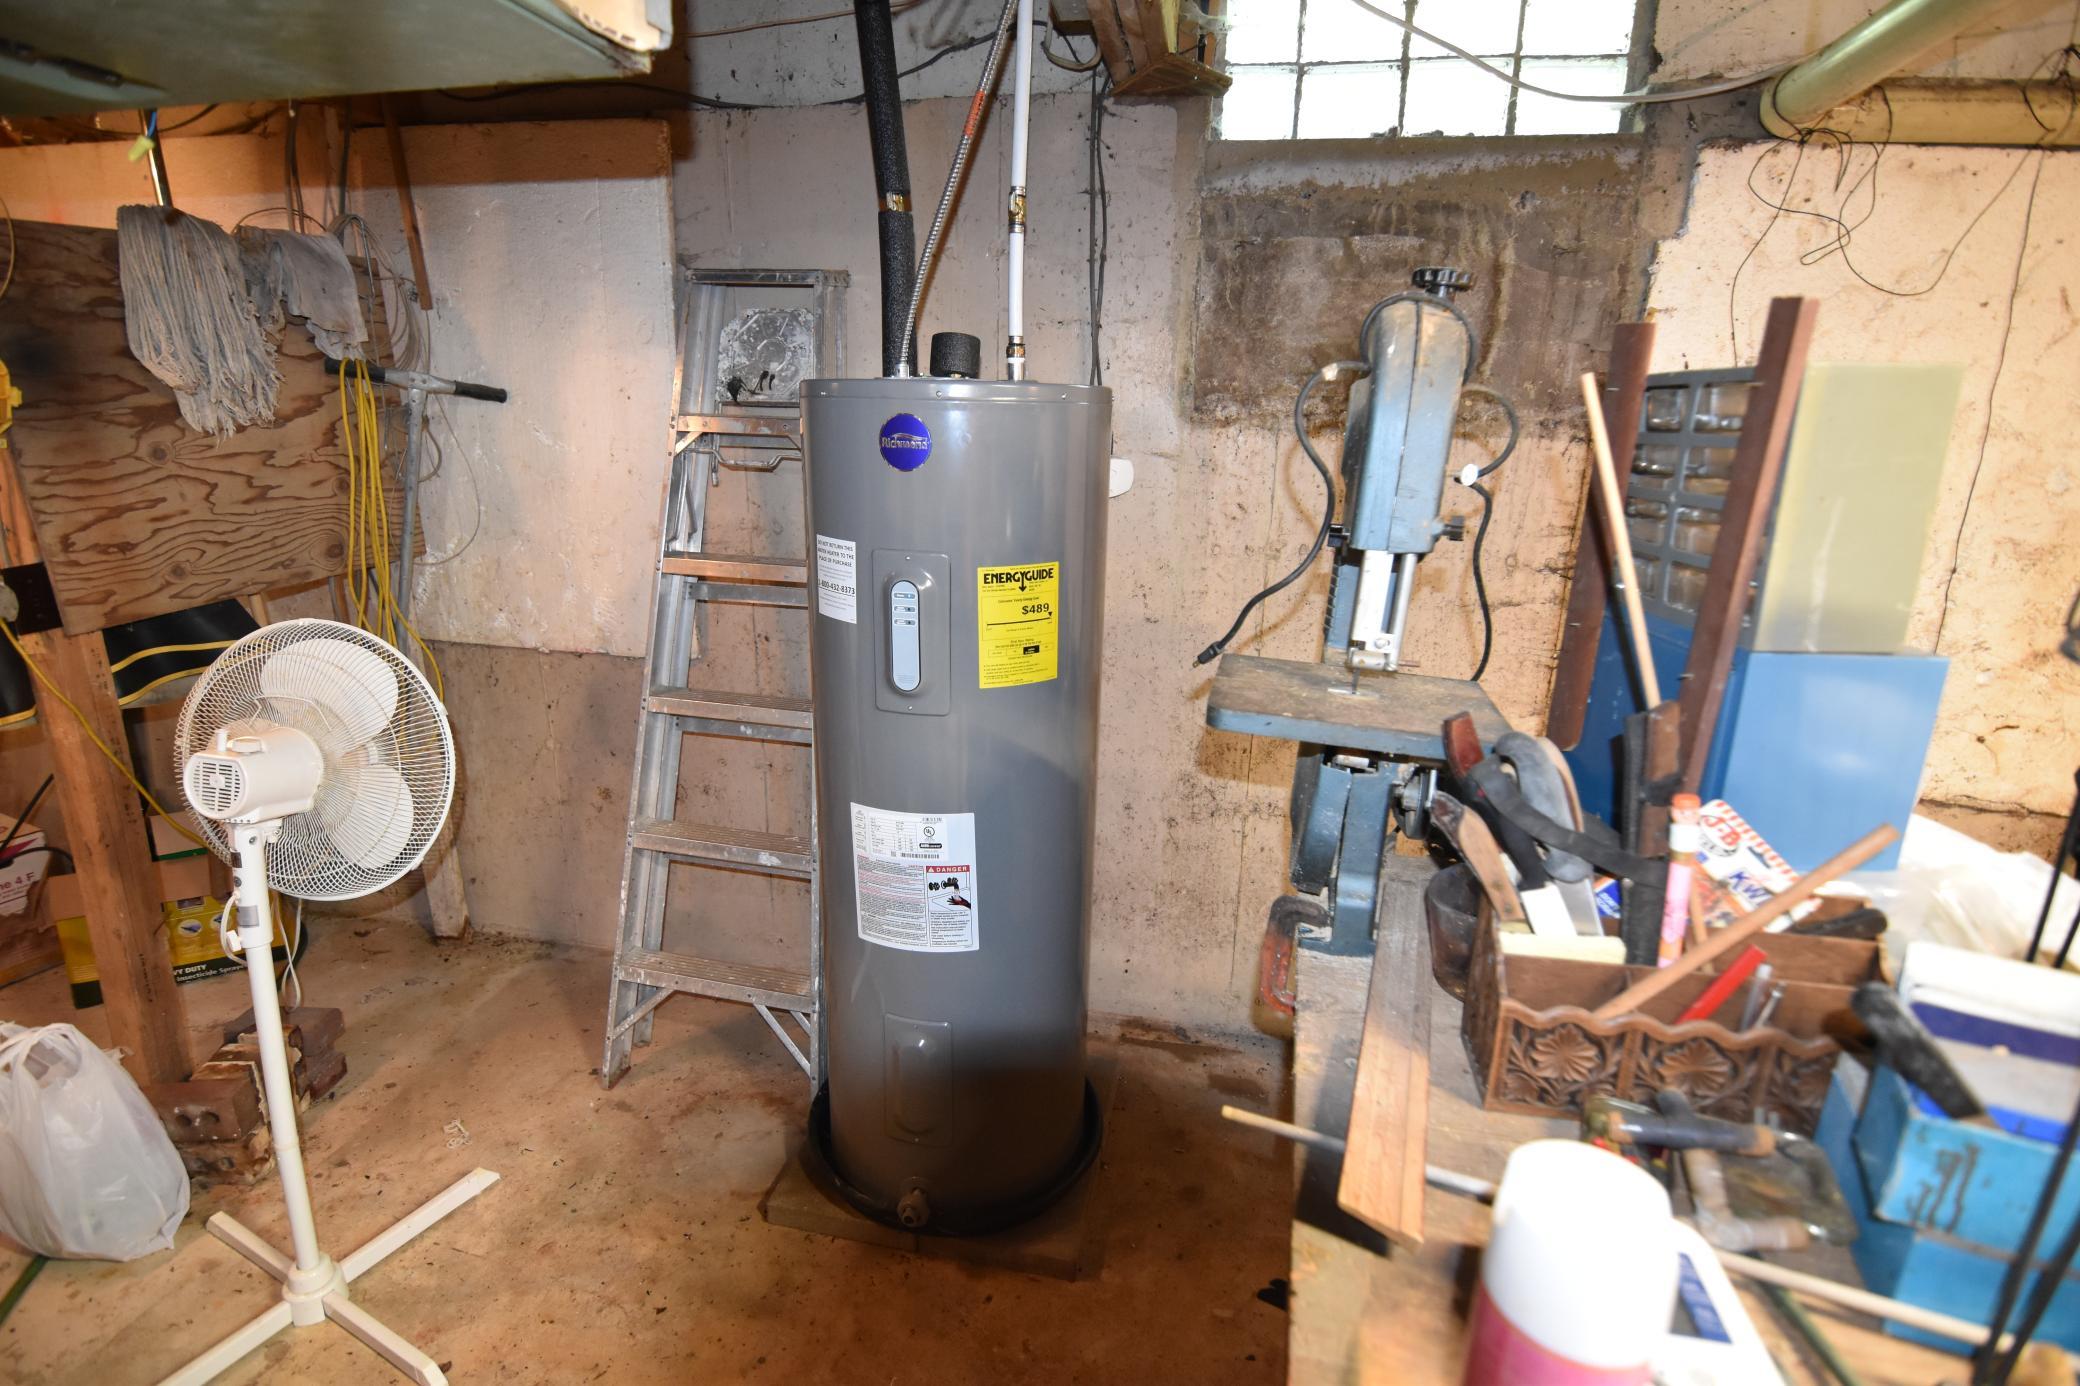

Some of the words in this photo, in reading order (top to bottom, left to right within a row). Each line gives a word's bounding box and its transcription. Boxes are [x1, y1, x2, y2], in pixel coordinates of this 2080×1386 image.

[984, 568, 1054, 588] ENERGYGUIDE
[1022, 603, 1049, 615] $489
[185, 964, 207, 974] DUTY
